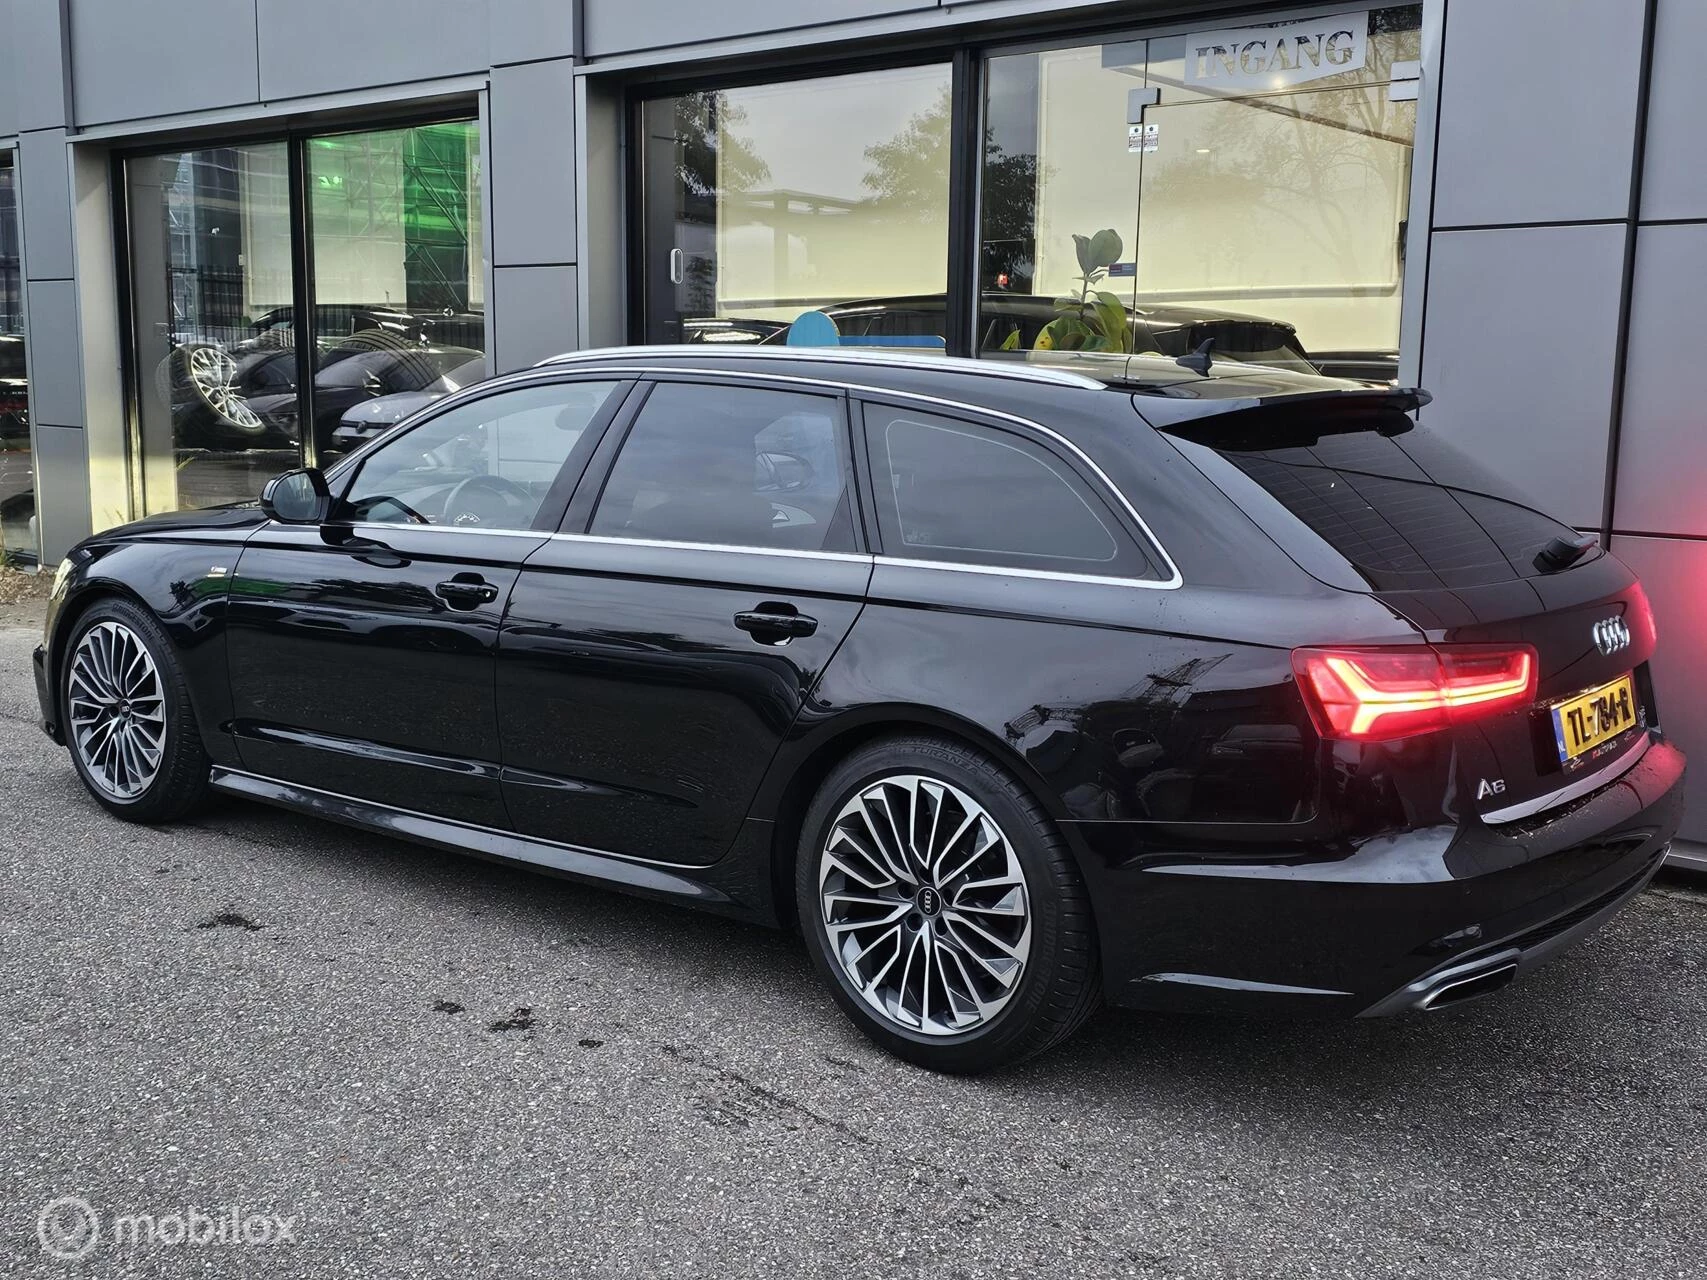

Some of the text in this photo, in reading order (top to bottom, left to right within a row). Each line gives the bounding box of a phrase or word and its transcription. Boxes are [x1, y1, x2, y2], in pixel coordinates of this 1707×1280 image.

[1195, 30, 1355, 79] INGANG
[1566, 686, 1632, 748] TL-784-R
[912, 746, 978, 776] TURANZA
[1477, 778, 1506, 800] A6
